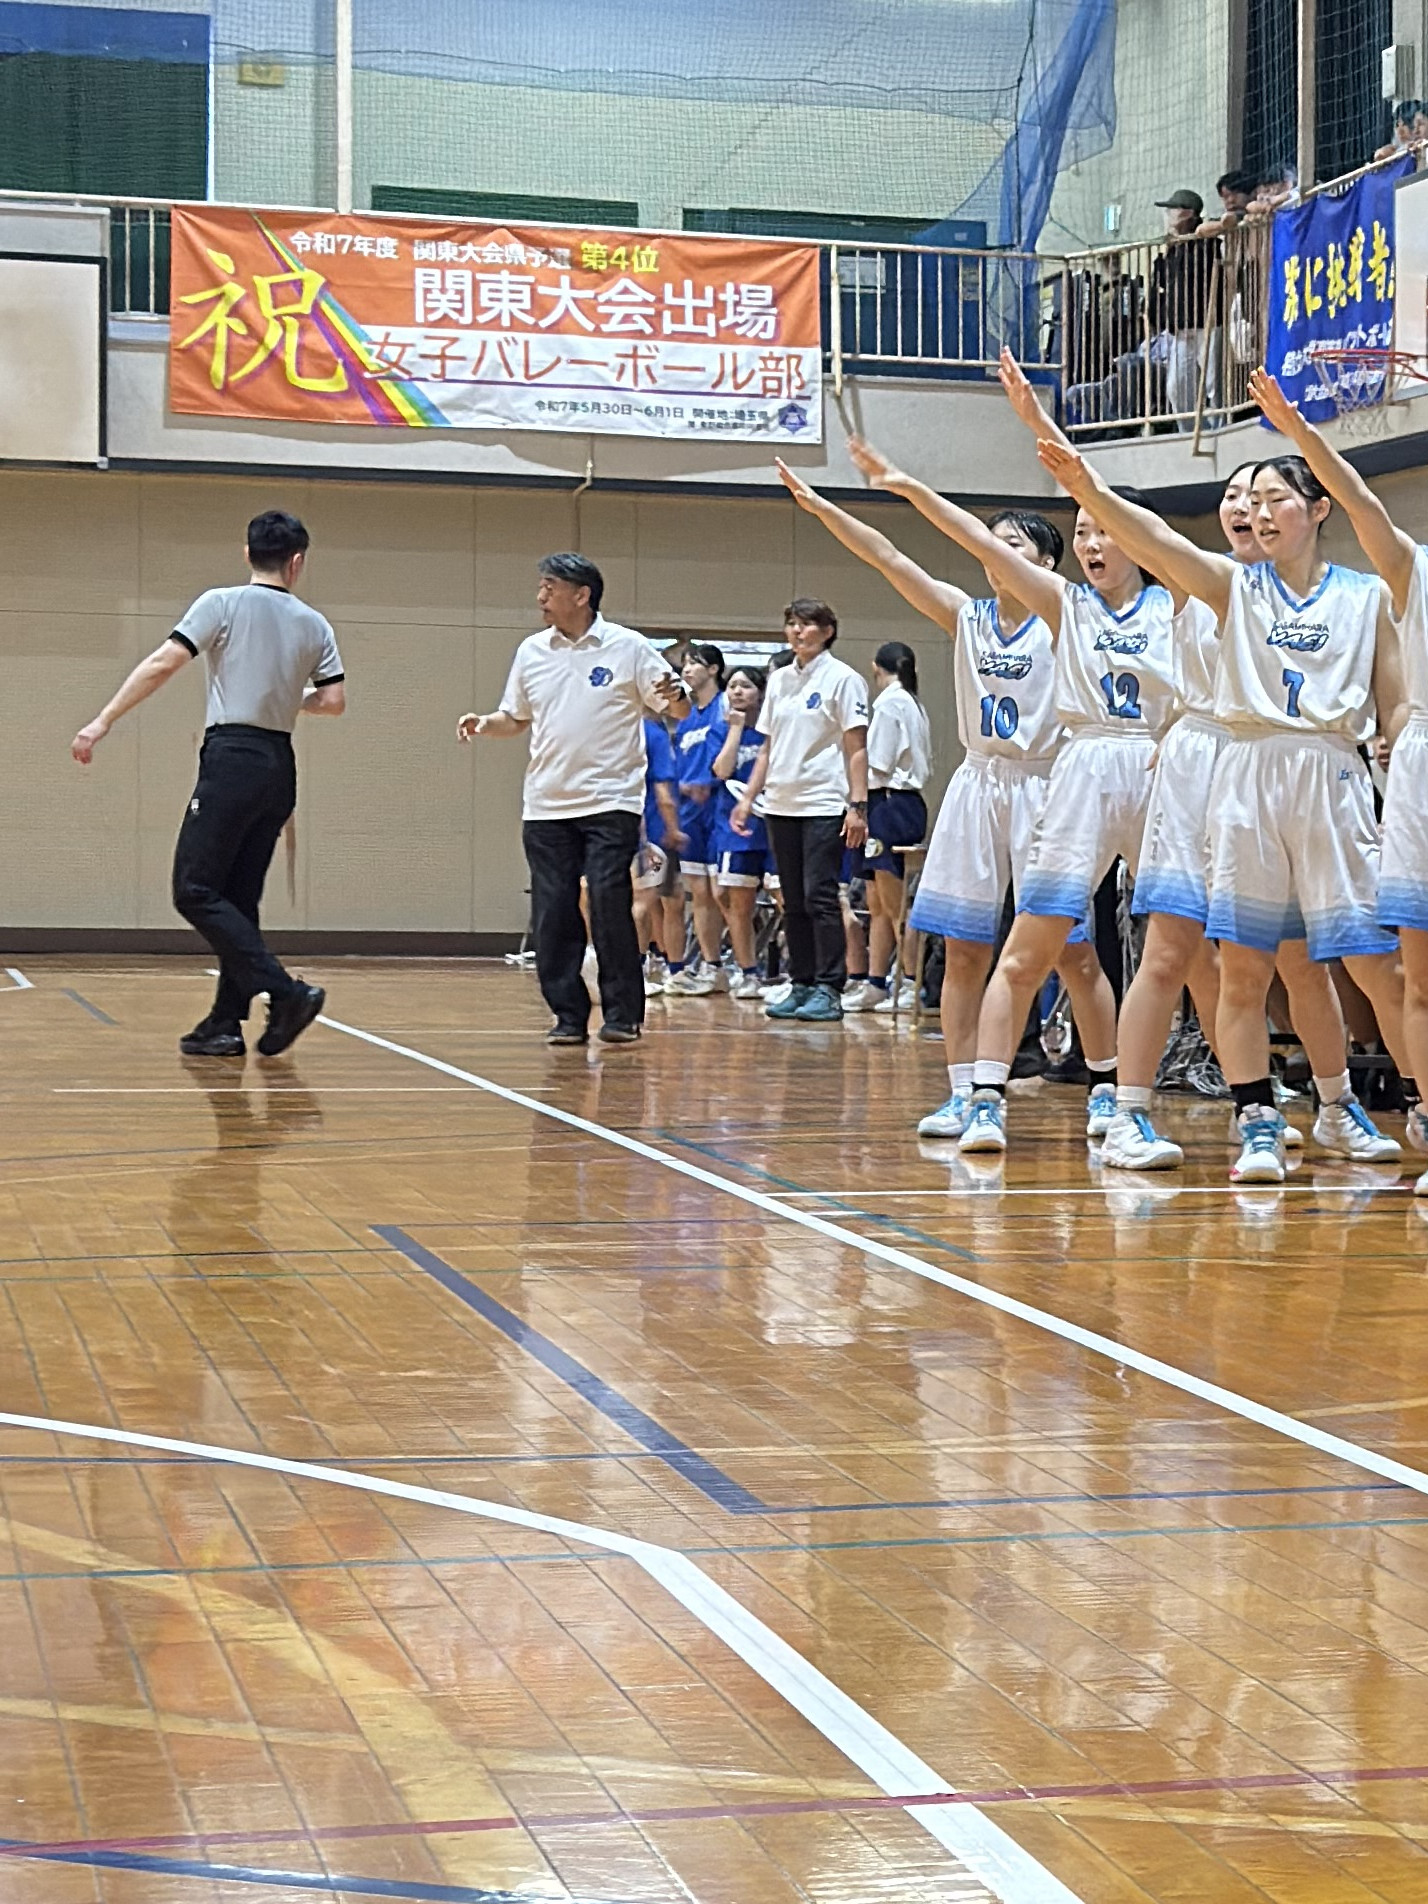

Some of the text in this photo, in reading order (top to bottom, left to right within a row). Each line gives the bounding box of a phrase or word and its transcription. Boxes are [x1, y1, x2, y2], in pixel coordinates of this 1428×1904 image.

[290, 231, 399, 260] 令和7年度
[580, 241, 660, 274] 第4位
[179, 248, 349, 394] 祝
[414, 267, 778, 340] 関東大会出場
[362, 330, 805, 398] 女子バレーボール部
[980, 694, 1019, 740] 10
[1100, 672, 1142, 719] 12
[1282, 668, 1304, 717] 7
